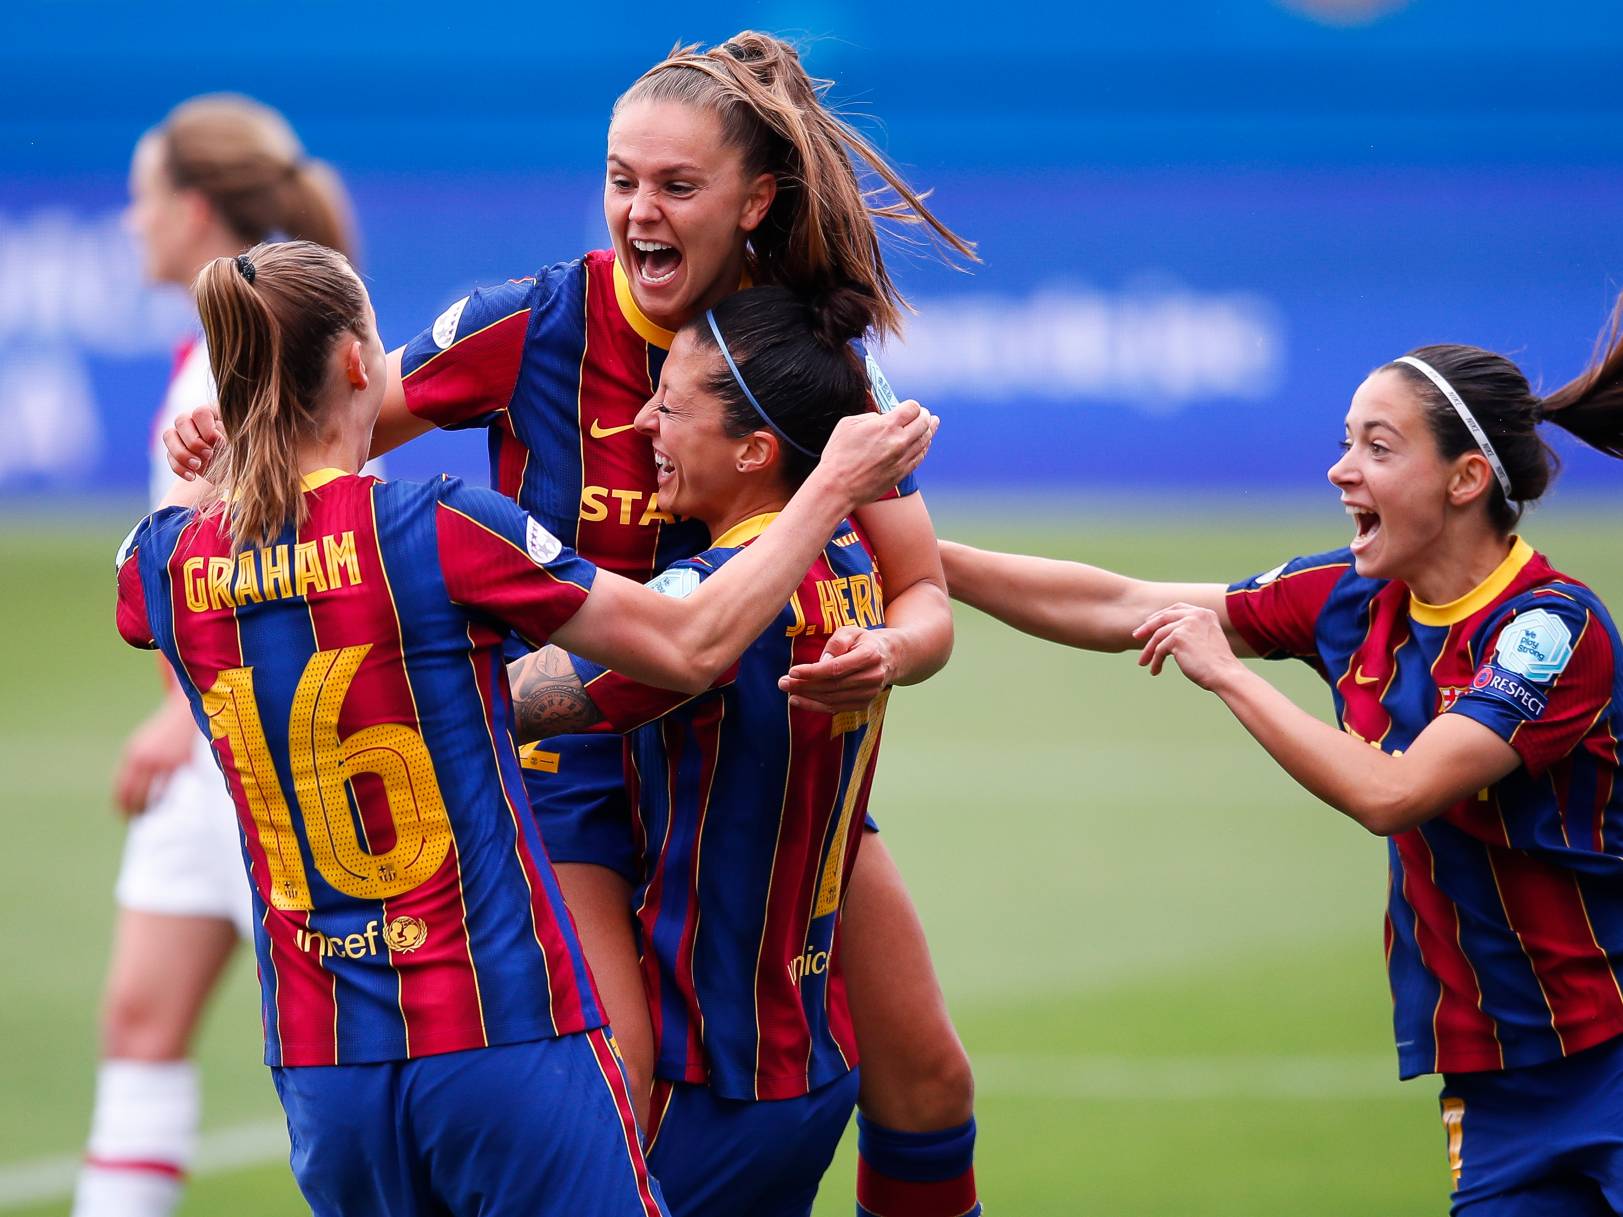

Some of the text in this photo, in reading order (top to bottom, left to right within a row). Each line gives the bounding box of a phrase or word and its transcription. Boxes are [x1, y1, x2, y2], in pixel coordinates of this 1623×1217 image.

[1466, 417, 1480, 433] NIKE
[1482, 442, 1495, 457] NIKE
[580, 485, 676, 526] STA
[183, 530, 362, 613] GRAHAM
[785, 590, 816, 638] J.
[1490, 675, 1544, 716] RESPECT
[201, 643, 452, 911] 16
[786, 945, 829, 986] unic
